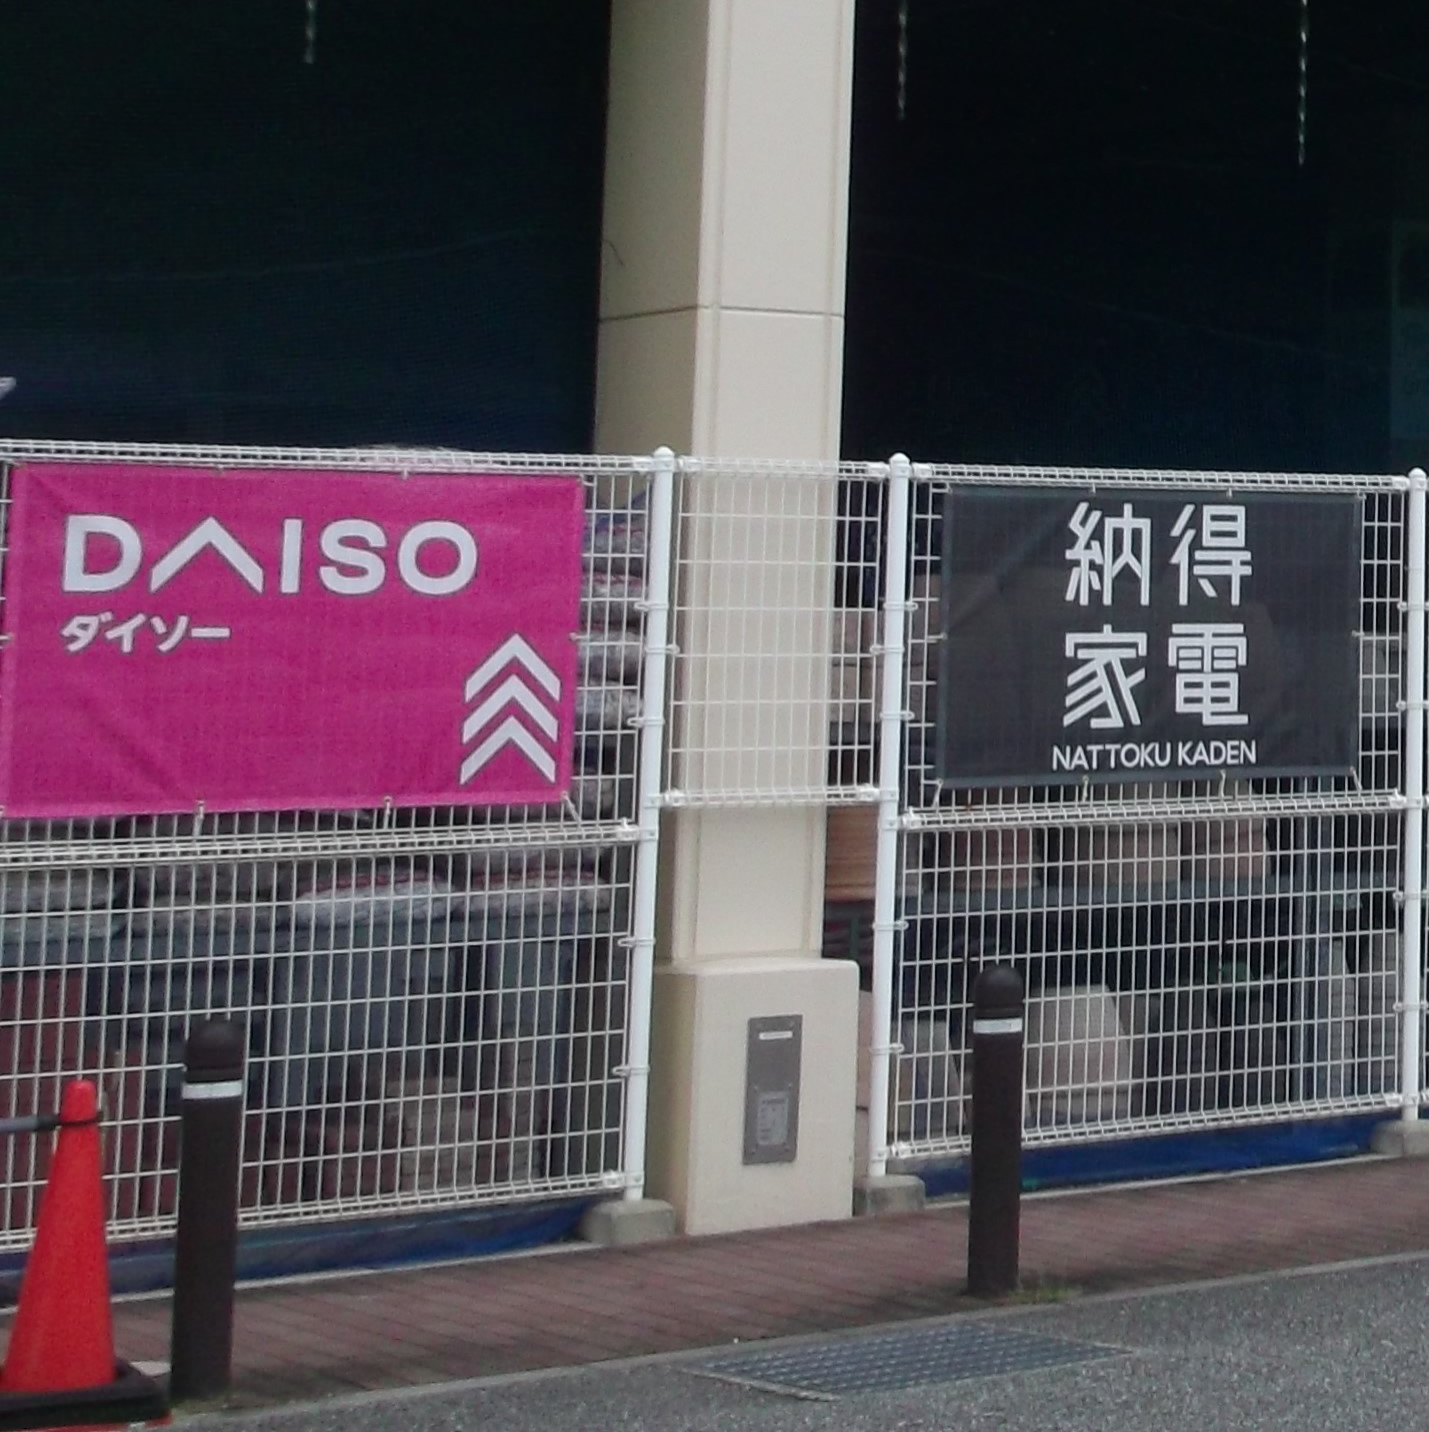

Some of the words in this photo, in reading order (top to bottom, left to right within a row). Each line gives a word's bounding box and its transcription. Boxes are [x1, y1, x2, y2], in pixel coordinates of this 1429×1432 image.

[61, 513, 479, 596] DAISO
[1063, 501, 1253, 607] 納得
[60, 612, 231, 654] ダイソー
[1062, 622, 1250, 730] 家電
[1051, 740, 1171, 772] NATTOKU
[1177, 738, 1258, 767] KADEN
